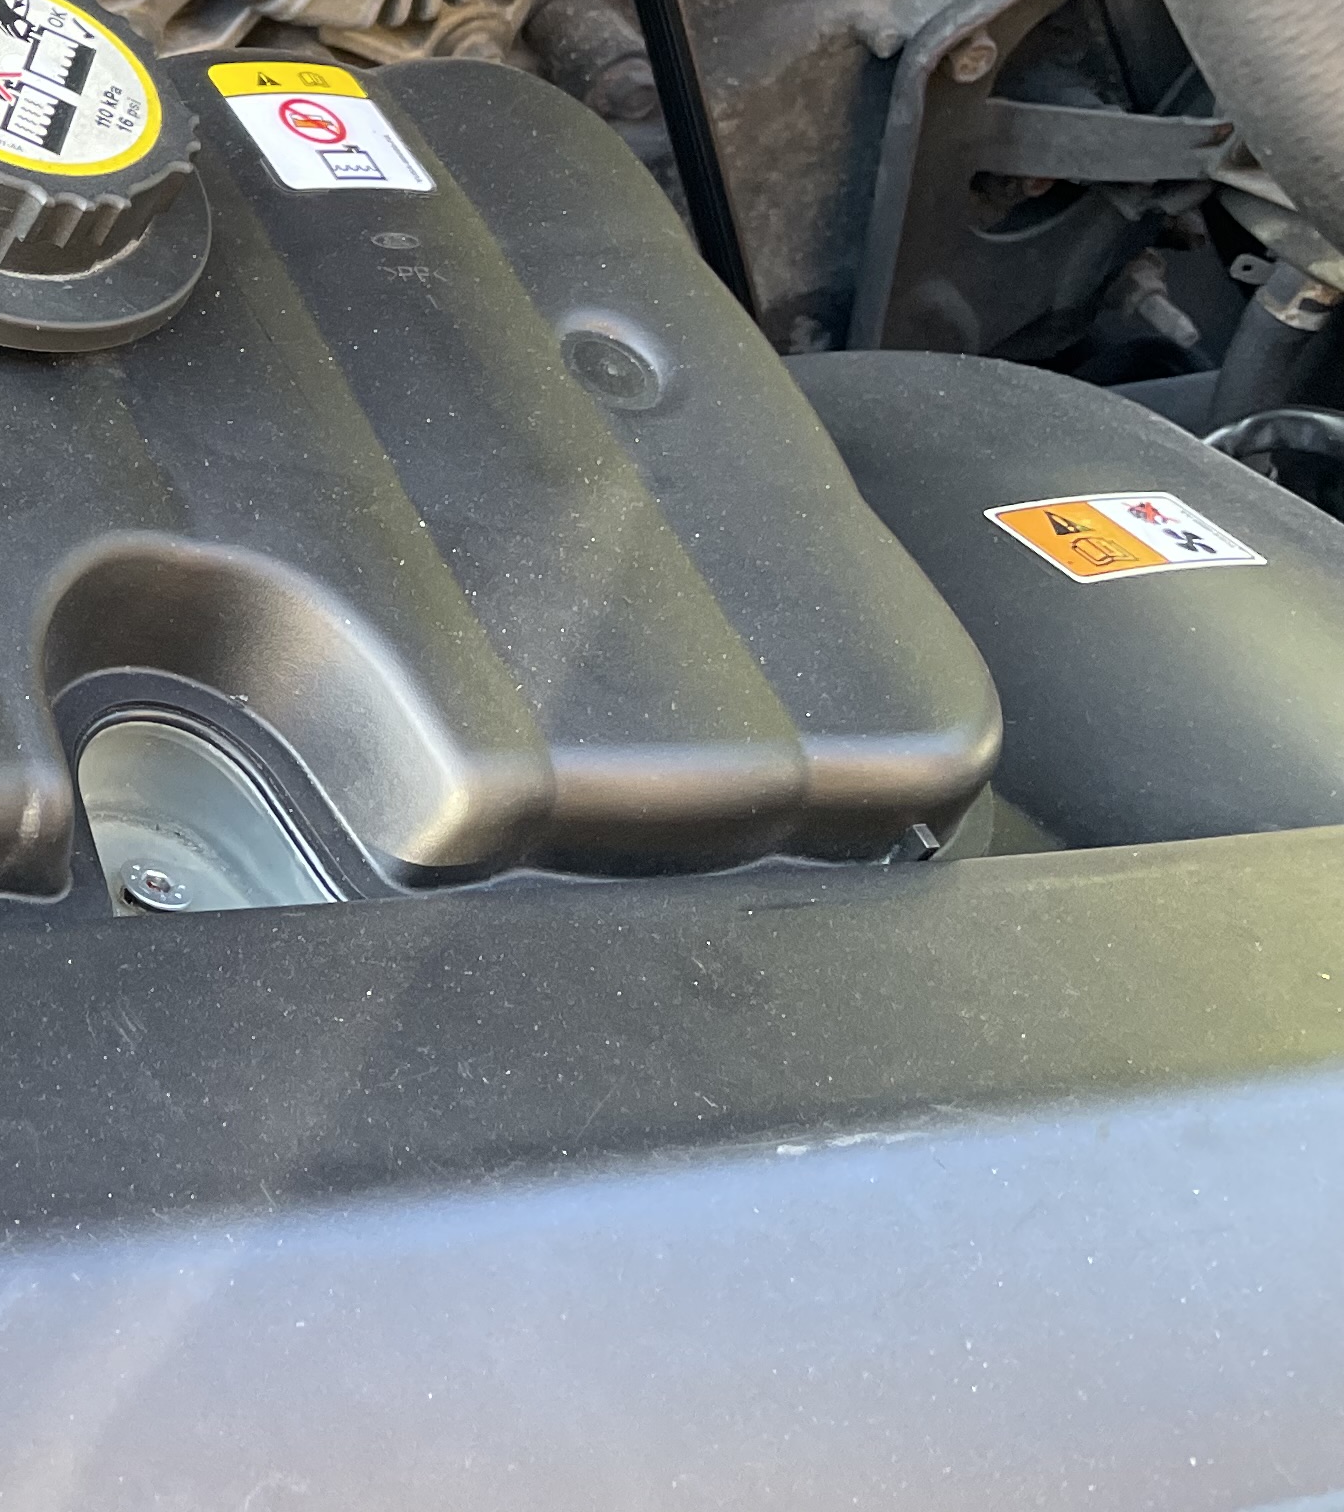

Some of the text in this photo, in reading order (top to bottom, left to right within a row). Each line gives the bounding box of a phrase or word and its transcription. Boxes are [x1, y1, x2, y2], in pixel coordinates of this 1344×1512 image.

[47, 6, 68, 29] OK
[95, 85, 123, 129] 110 kPa
[115, 96, 142, 134] 16 psi
